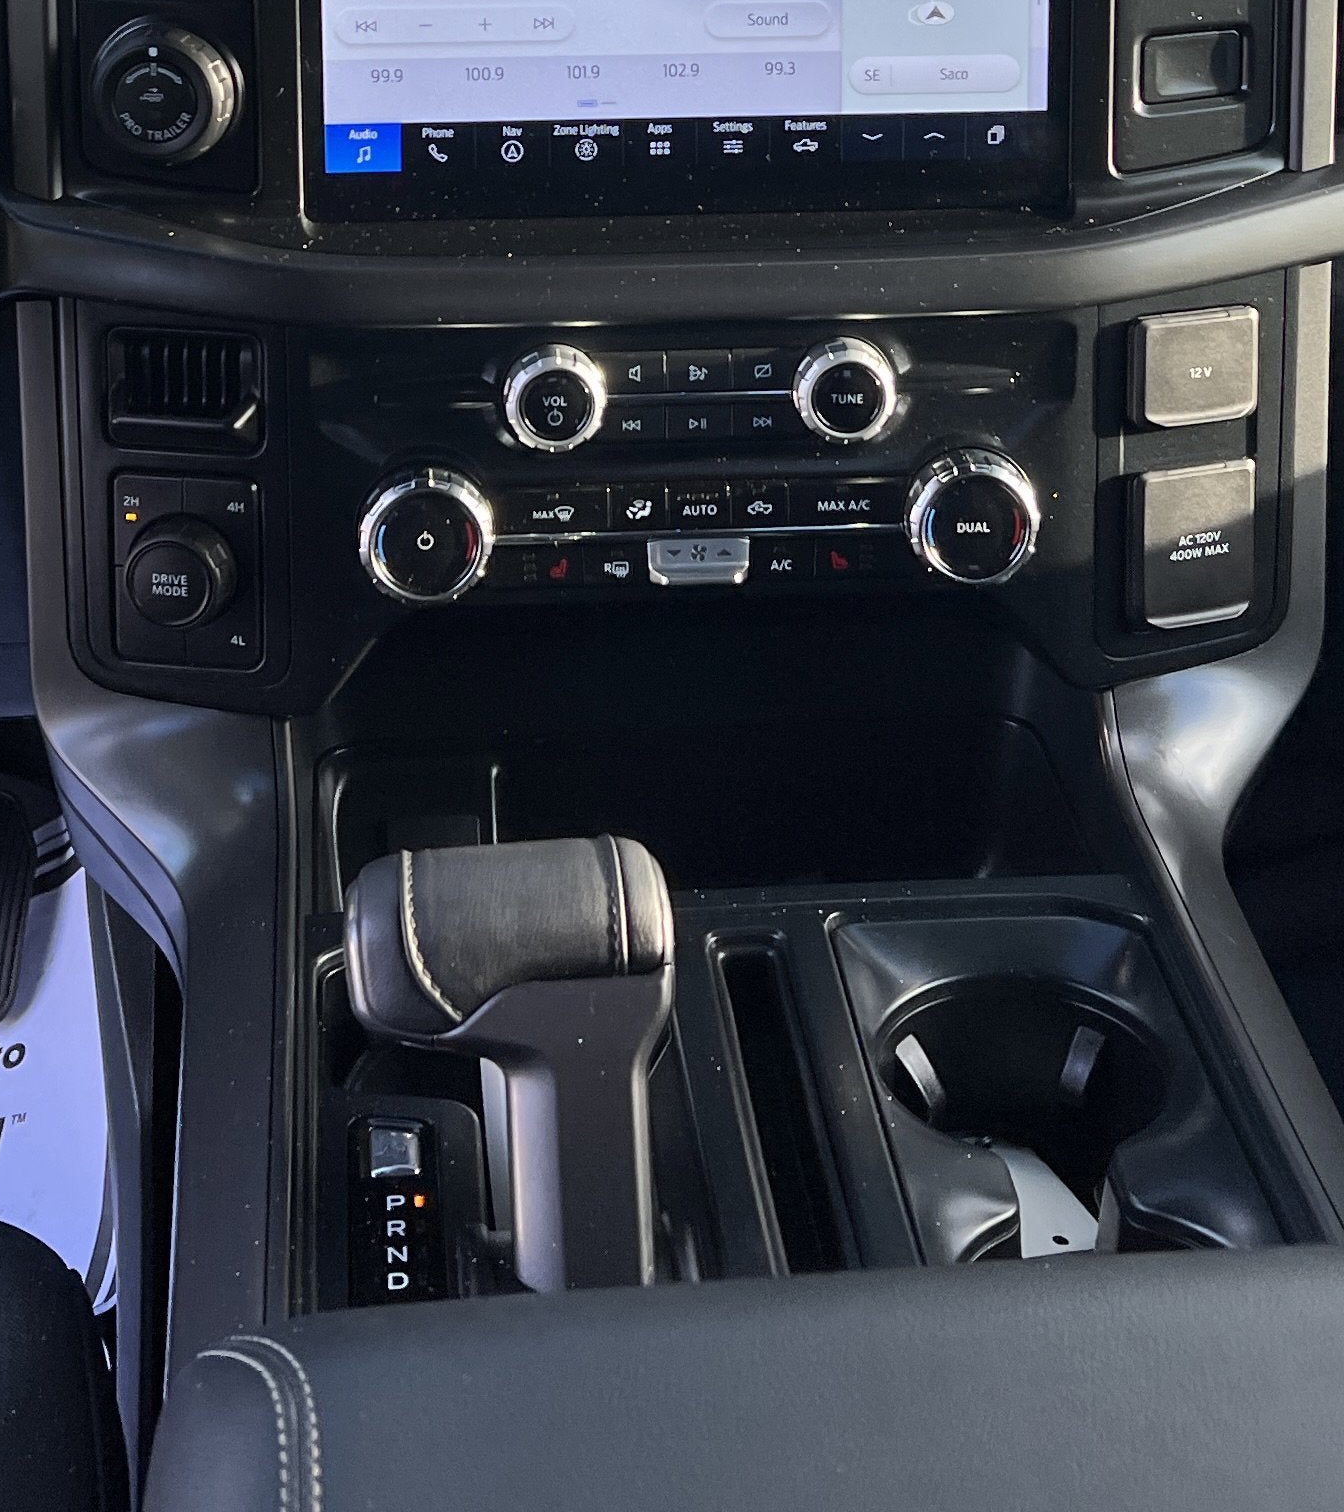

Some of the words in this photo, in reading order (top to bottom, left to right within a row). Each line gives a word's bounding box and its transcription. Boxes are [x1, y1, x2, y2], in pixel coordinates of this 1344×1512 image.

[747, 12, 789, 27] Sound
[370, 68, 404, 83] 99.9
[464, 66, 505, 81] 100.9
[566, 64, 601, 79] 101.9
[662, 62, 700, 78] 102.9
[764, 61, 797, 77] 99.3
[864, 68, 881, 82] SE
[939, 66, 970, 81] Saco
[120, 112, 143, 136] PRO
[146, 112, 194, 141] TRAILER
[421, 126, 455, 139] Phone
[502, 126, 523, 137] Nav
[552, 124, 578, 136] Zone
[579, 124, 620, 138] Lighting
[647, 123, 673, 135] Apps
[712, 121, 754, 135] Settings
[784, 120, 828, 132] Features
[348, 128, 378, 140] Audio
[1189, 367, 1202, 379] 12
[1202, 367, 1213, 379] V
[542, 396, 568, 407] VOL
[830, 393, 864, 405] TUNE
[123, 495, 140, 507] 2H
[226, 502, 245, 513] 4H
[817, 501, 845, 512] MAX
[848, 499, 871, 511] A/C
[532, 510, 555, 520] MAX
[682, 504, 718, 516] AUTO
[956, 521, 991, 534] DUAL
[1178, 534, 1194, 547] AC
[1194, 530, 1222, 545] 120V
[1169, 546, 1203, 562] 400W
[1204, 542, 1230, 557] MAX
[770, 559, 792, 571] A/C
[152, 573, 188, 586] DRIVE
[152, 585, 188, 597] MODE
[230, 635, 246, 647] 4L
[386, 1194, 405, 1211] P
[386, 1220, 406, 1237] R
[387, 1246, 408, 1264] N
[387, 1272, 409, 1290] D
